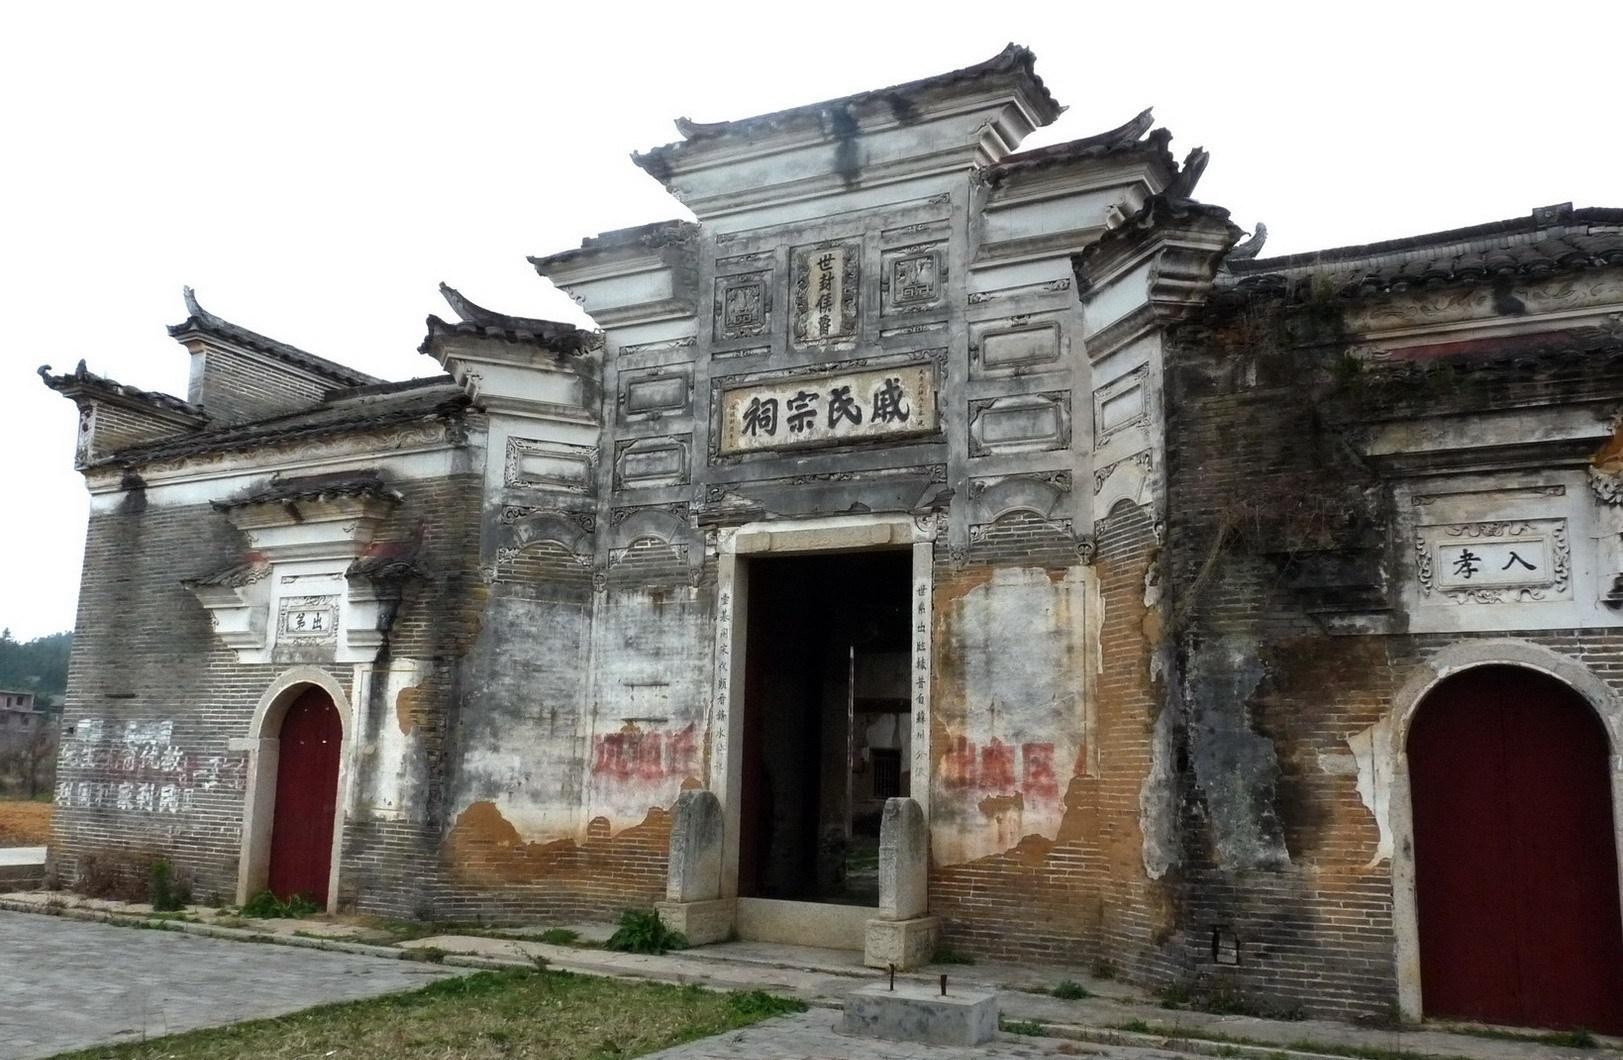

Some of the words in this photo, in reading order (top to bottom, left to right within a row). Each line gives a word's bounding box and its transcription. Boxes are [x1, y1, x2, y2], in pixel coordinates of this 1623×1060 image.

[816, 253, 835, 336] 世封侯爵
[1453, 548, 1537, 579] 入孝
